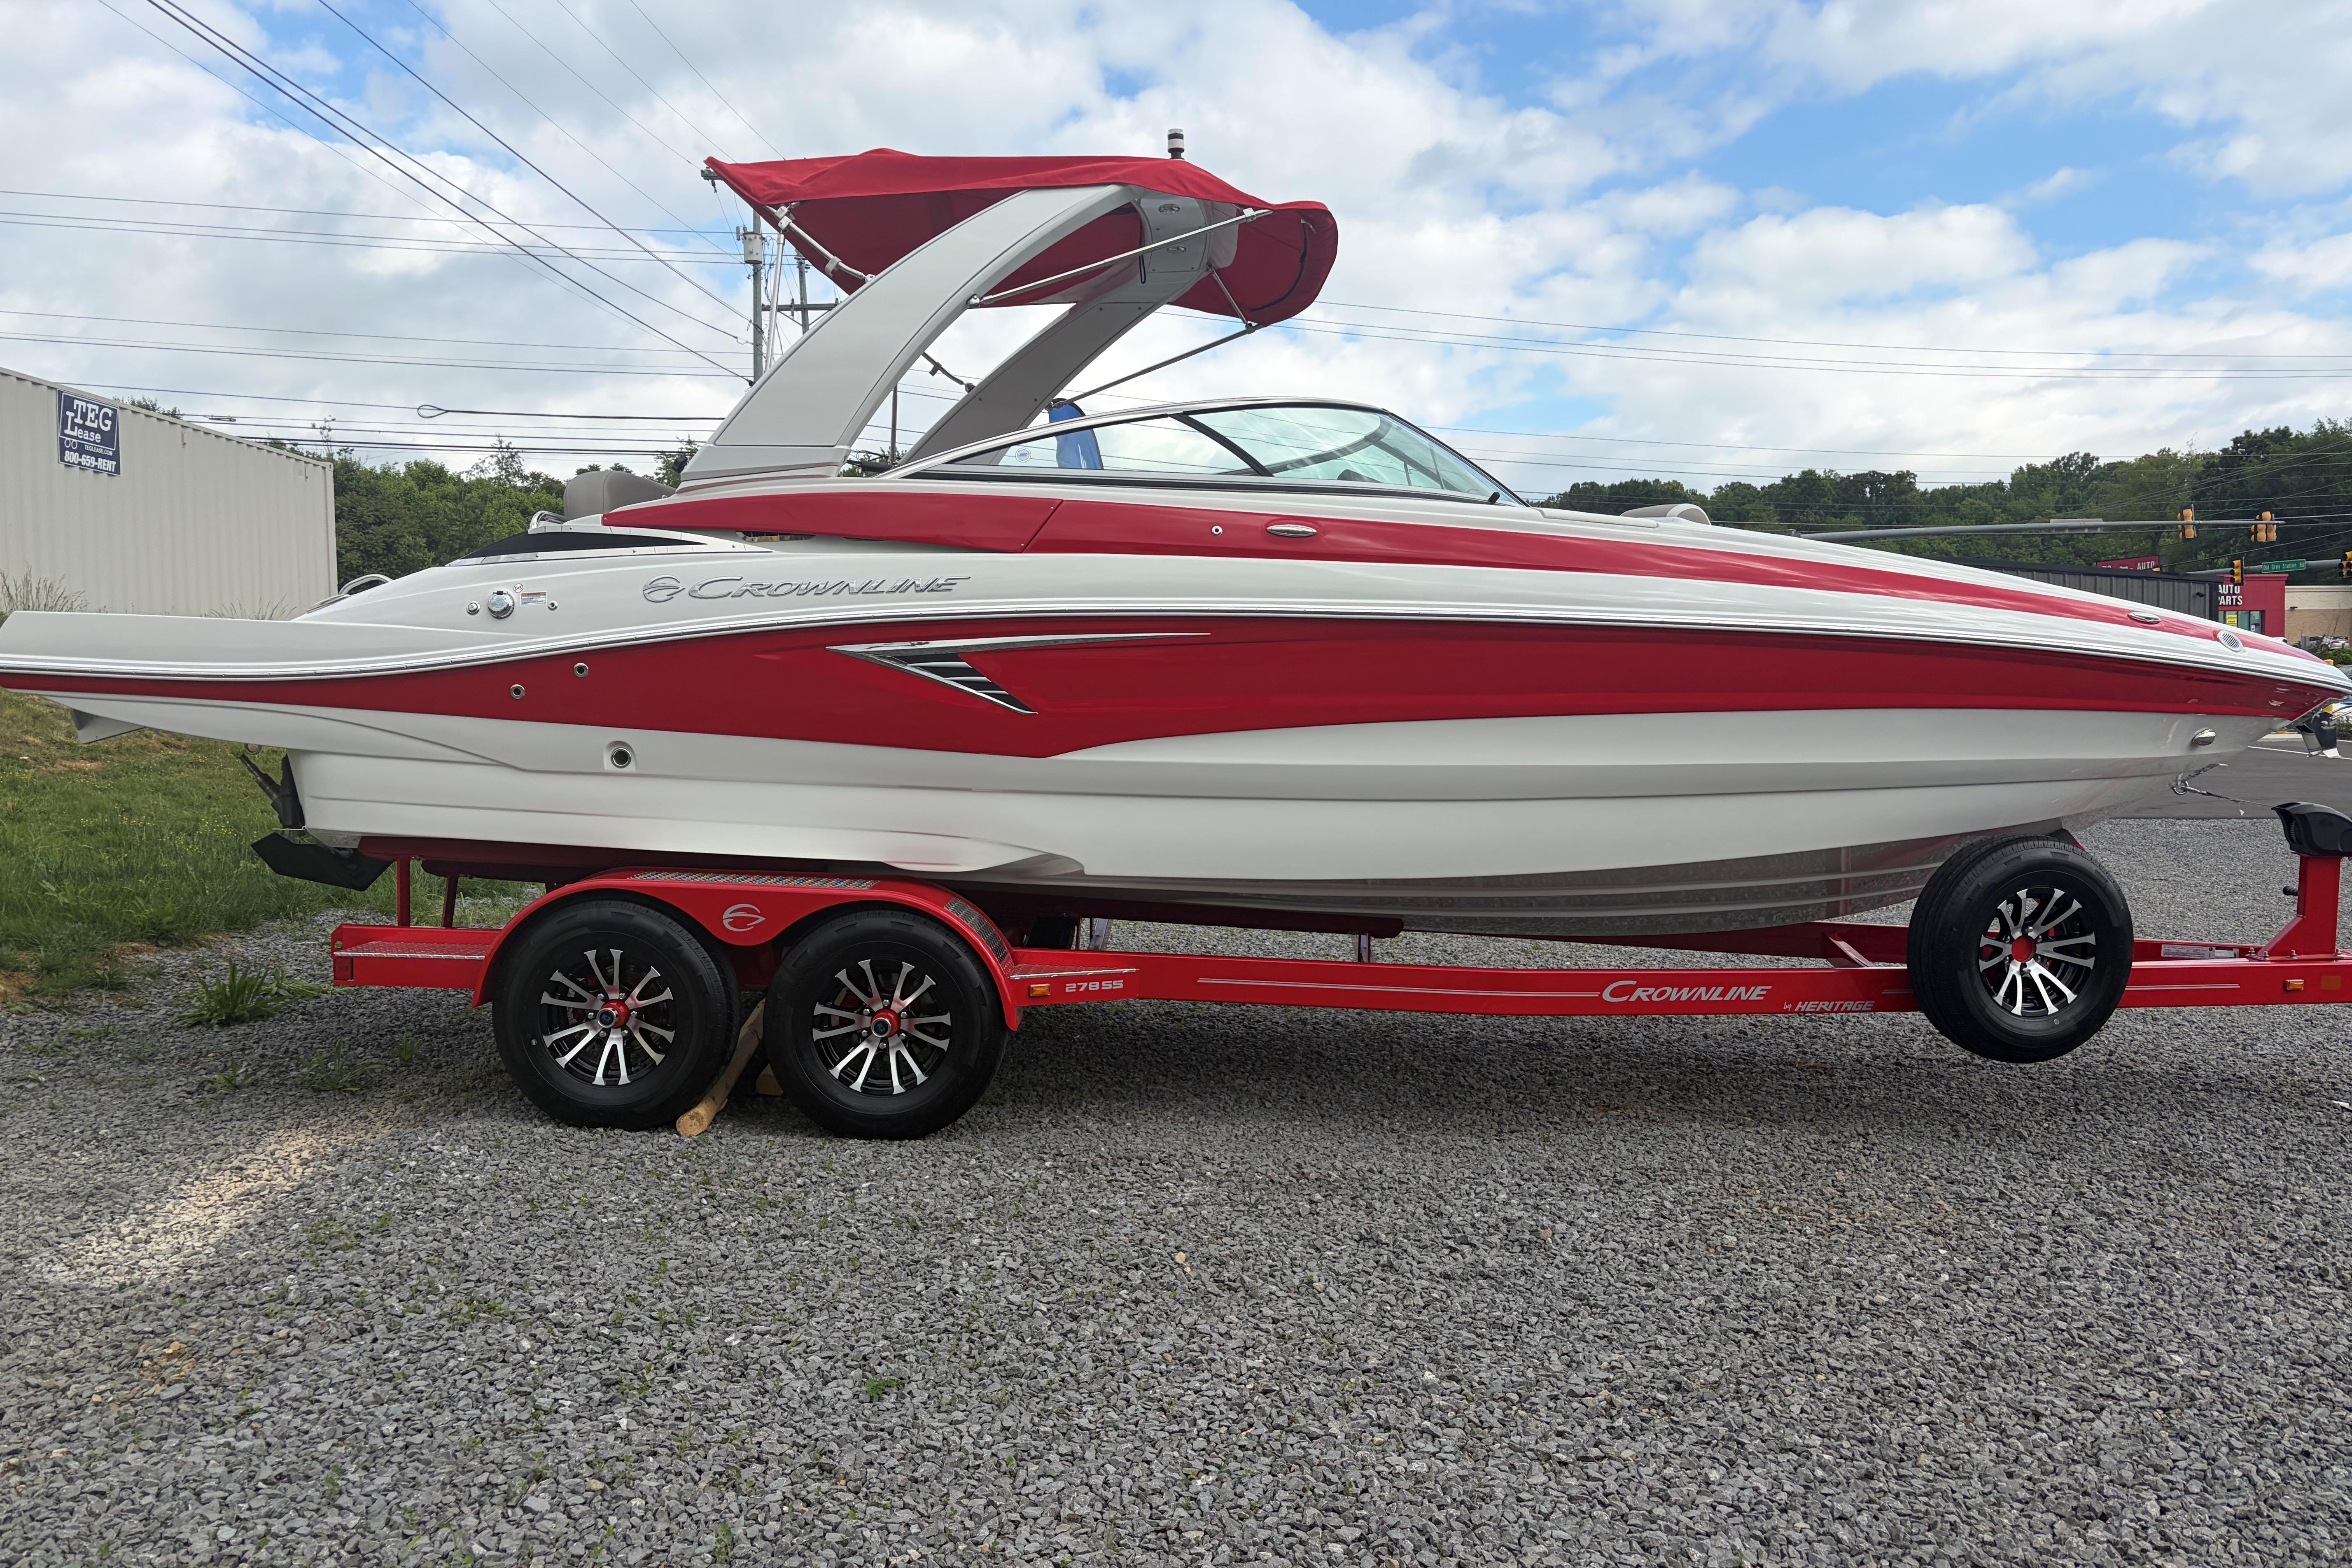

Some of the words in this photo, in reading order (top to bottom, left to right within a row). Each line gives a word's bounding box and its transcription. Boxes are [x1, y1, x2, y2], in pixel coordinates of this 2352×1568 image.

[73, 399, 112, 431] TEG
[64, 411, 101, 443] Lease
[64, 450, 116, 472] 800-659-RENT
[84, 445, 113, 456] TEGLEASE.COM
[689, 575, 972, 598] CROWNLINE
[2218, 584, 2240, 594] AUTO
[2218, 595, 2243, 605] ARTS
[1602, 980, 1772, 1002] CROWNLINE
[1783, 1001, 1792, 1011] by
[1794, 1001, 1875, 1011] HERITAGE
